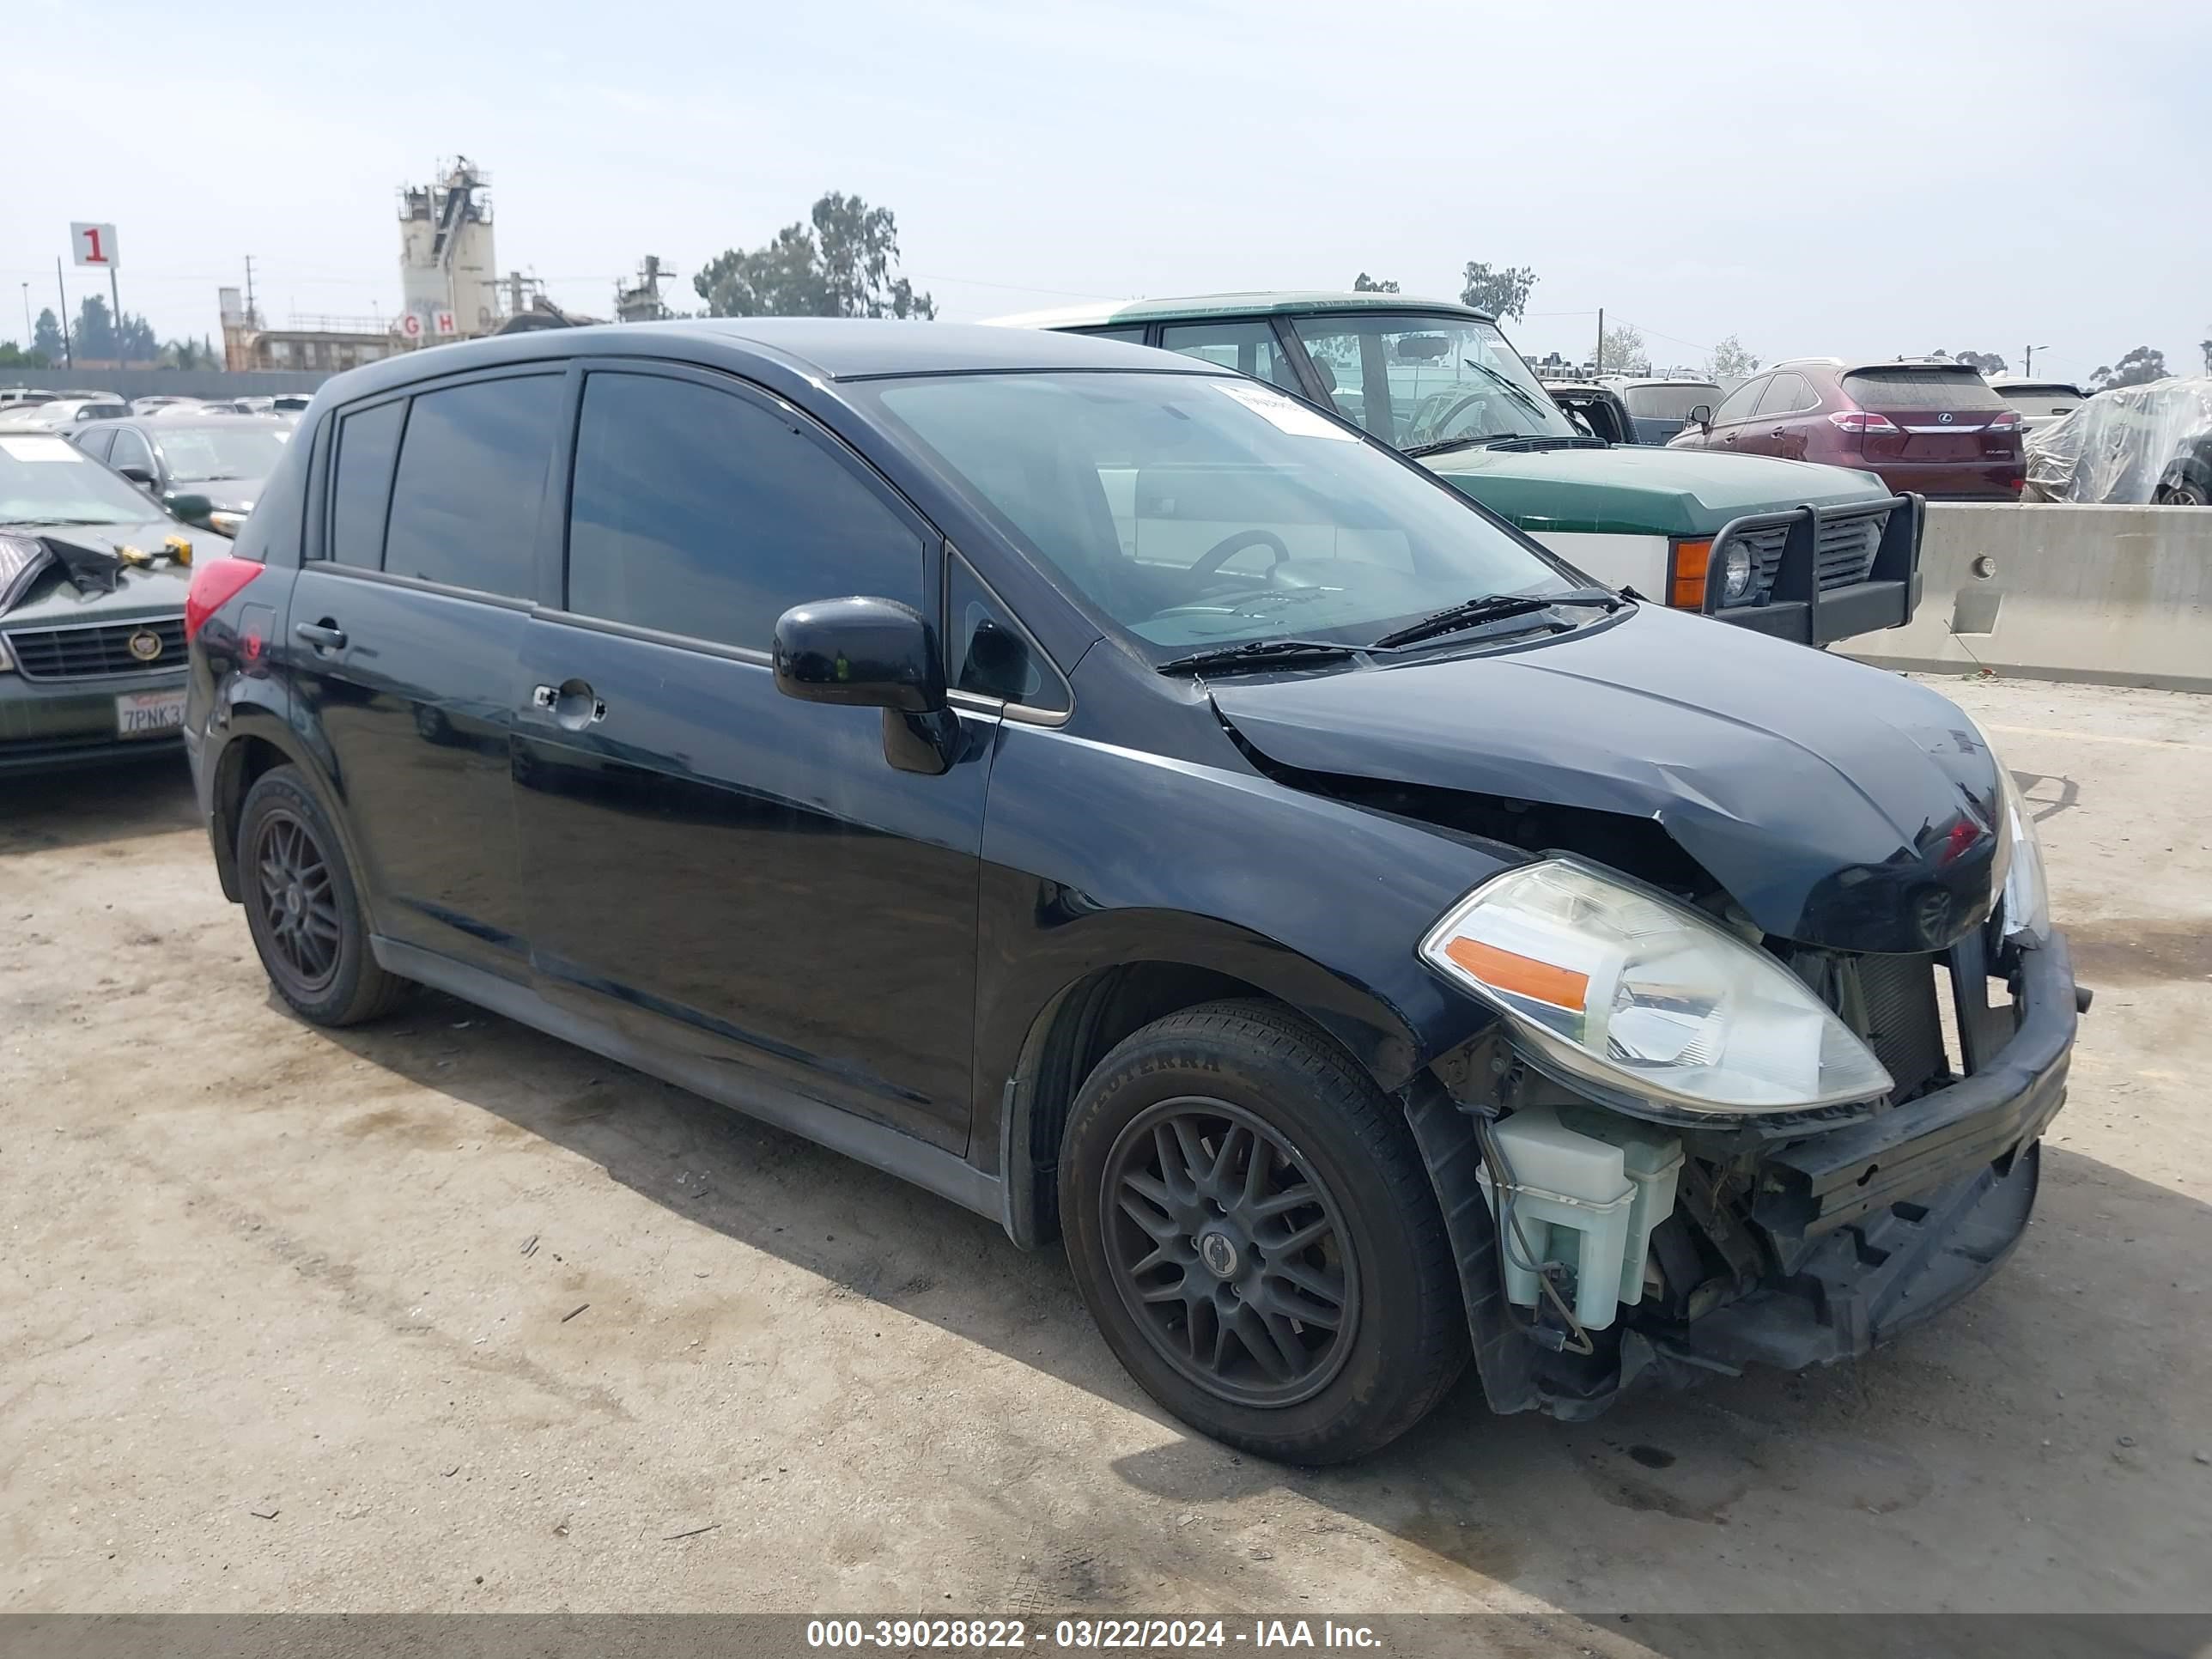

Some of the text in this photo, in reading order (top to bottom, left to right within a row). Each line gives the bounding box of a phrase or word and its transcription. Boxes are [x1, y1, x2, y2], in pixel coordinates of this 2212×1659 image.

[82, 228, 109, 262] 1
[404, 315, 420, 335] G
[439, 314, 453, 331] H
